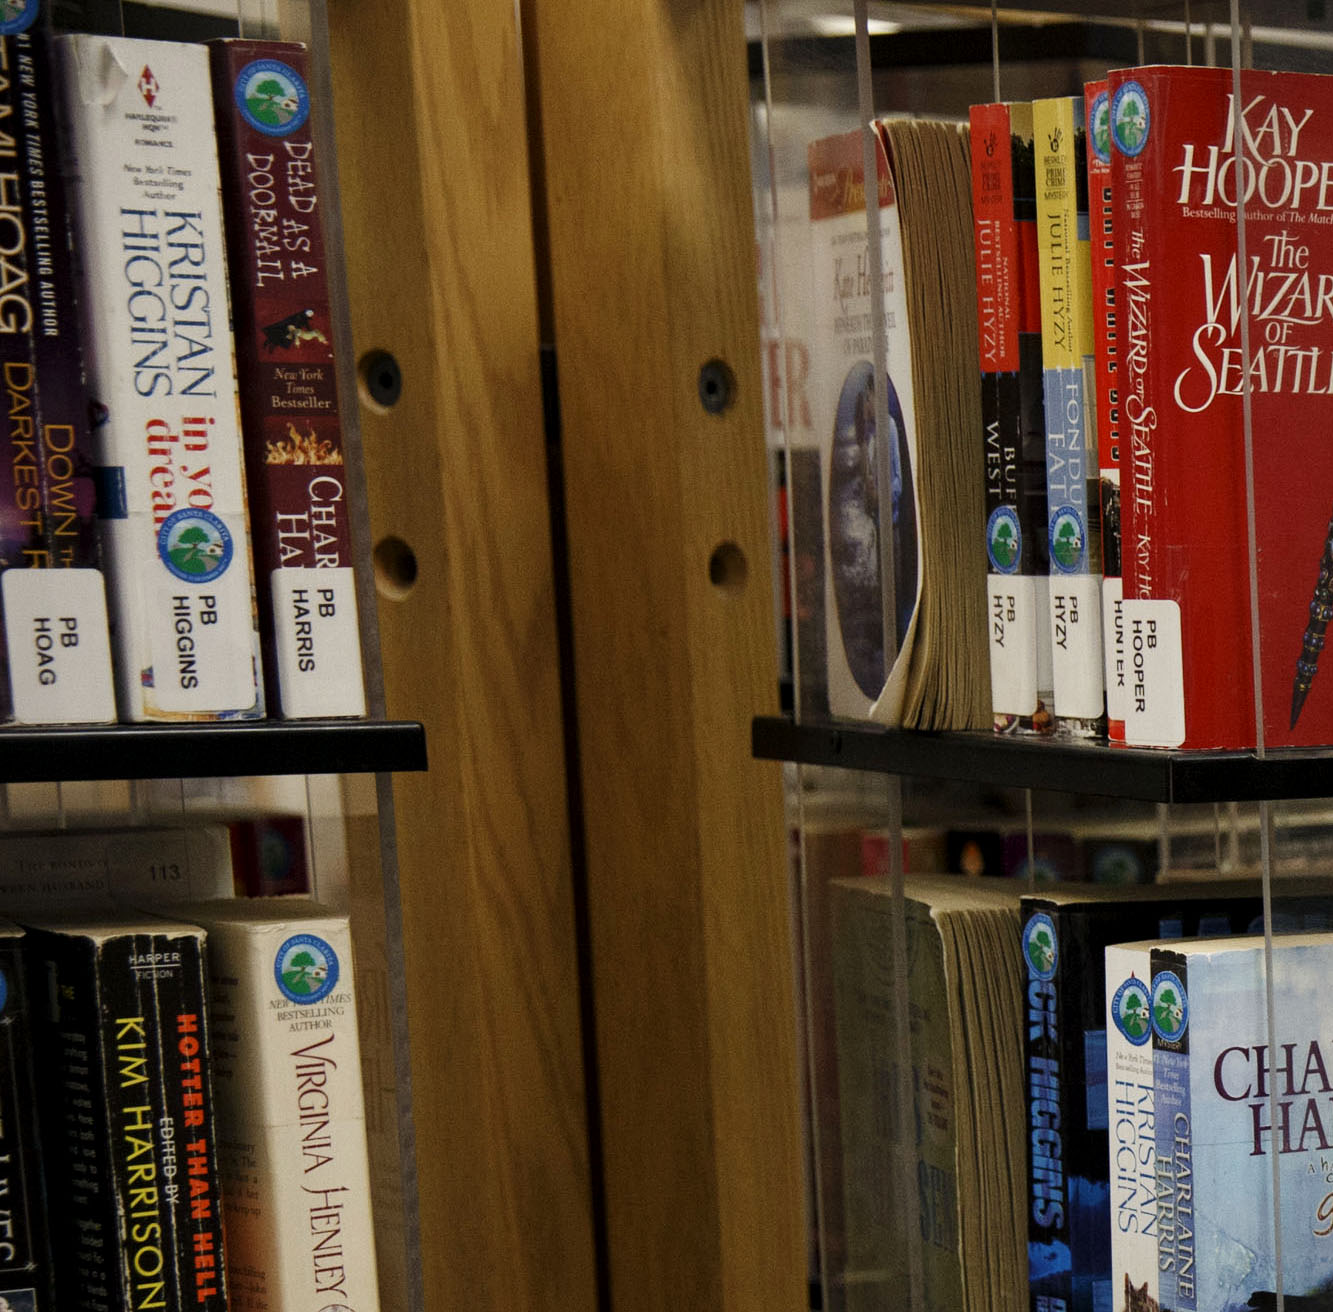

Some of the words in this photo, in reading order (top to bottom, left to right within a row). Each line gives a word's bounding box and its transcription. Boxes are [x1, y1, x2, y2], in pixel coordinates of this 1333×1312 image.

[17, 53, 36, 88] NEW
[21, 92, 40, 127] YORK
[1222, 93, 1314, 167] KAY
[25, 133, 44, 176] TIMES
[284, 141, 317, 214] DEAD
[30, 181, 54, 276] BESTSELLING
[283, 219, 309, 252] AS
[1047, 214, 1063, 277] JULIE
[1263, 230, 1309, 269] The
[1289, 211, 1306, 223] The
[291, 265, 318, 280] A
[977, 219, 994, 285] JULIE
[40, 282, 58, 337] AUTHOR
[120, 207, 173, 397] HIGGINS
[164, 209, 216, 397] KRISTAN
[982, 296, 997, 364] HYZY
[1053, 287, 1066, 350] HYZY
[1121, 260, 1151, 383] WIZARD
[1264, 322, 1294, 343] OF
[3, 362, 43, 535] DARKEST
[44, 424, 78, 535] DOWN
[985, 421, 1002, 497] WEST
[1124, 394, 1158, 516] SEATTLE
[59, 617, 79, 648] PB
[198, 595, 218, 625] PB
[292, 589, 315, 672] HARRIS
[317, 588, 336, 618] PB
[993, 595, 1006, 648] HYZY
[1007, 596, 1016, 622] PB
[1054, 596, 1067, 650] HYZY
[1069, 596, 1079, 624] PB
[1147, 620, 1157, 649] PB
[33, 617, 56, 686] HOAG
[172, 596, 198, 689] HIGGINS
[1132, 620, 1146, 714] HOOPER
[130, 952, 181, 965] HARPER
[115, 1016, 150, 1089] KIM
[289, 1020, 332, 1033] AUTHOR
[176, 1013, 204, 1129] HOTTER
[290, 1033, 337, 1175] VIRGINIA
[159, 1116, 177, 1177] EDITED
[1029, 1055, 1066, 1229] HIGGINS
[1115, 1080, 1139, 1234] HIGGINS
[122, 1105, 166, 1311] HARRISON
[185, 1138, 211, 1220] THAN
[1157, 1155, 1176, 1272] HARRIS
[1174, 1112, 1194, 1298] CHARLAINE
[191, 1231, 218, 1304] HELL
[300, 1184, 351, 1298] HENLEY
